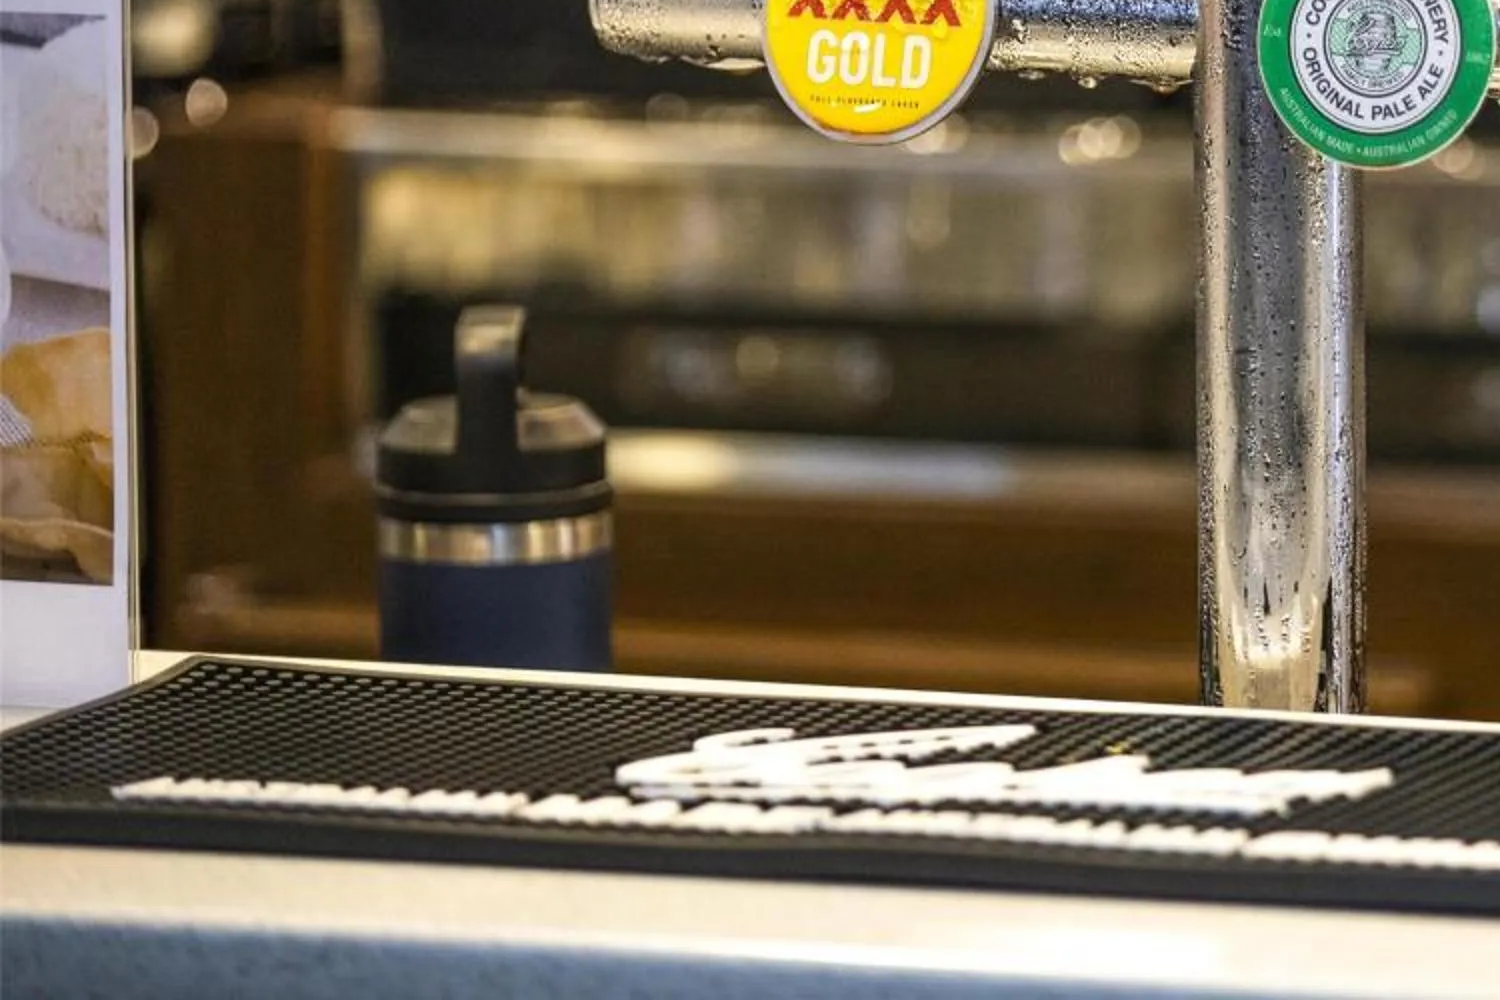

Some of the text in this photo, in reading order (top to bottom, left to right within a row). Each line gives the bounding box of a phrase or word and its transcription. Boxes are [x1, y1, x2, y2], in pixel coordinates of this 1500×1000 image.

[806, 28, 933, 90] GOLD
[1302, 46, 1366, 120] ORIGINAL
[1370, 94, 1418, 121] PALE
[1418, 63, 1445, 101] ALE
